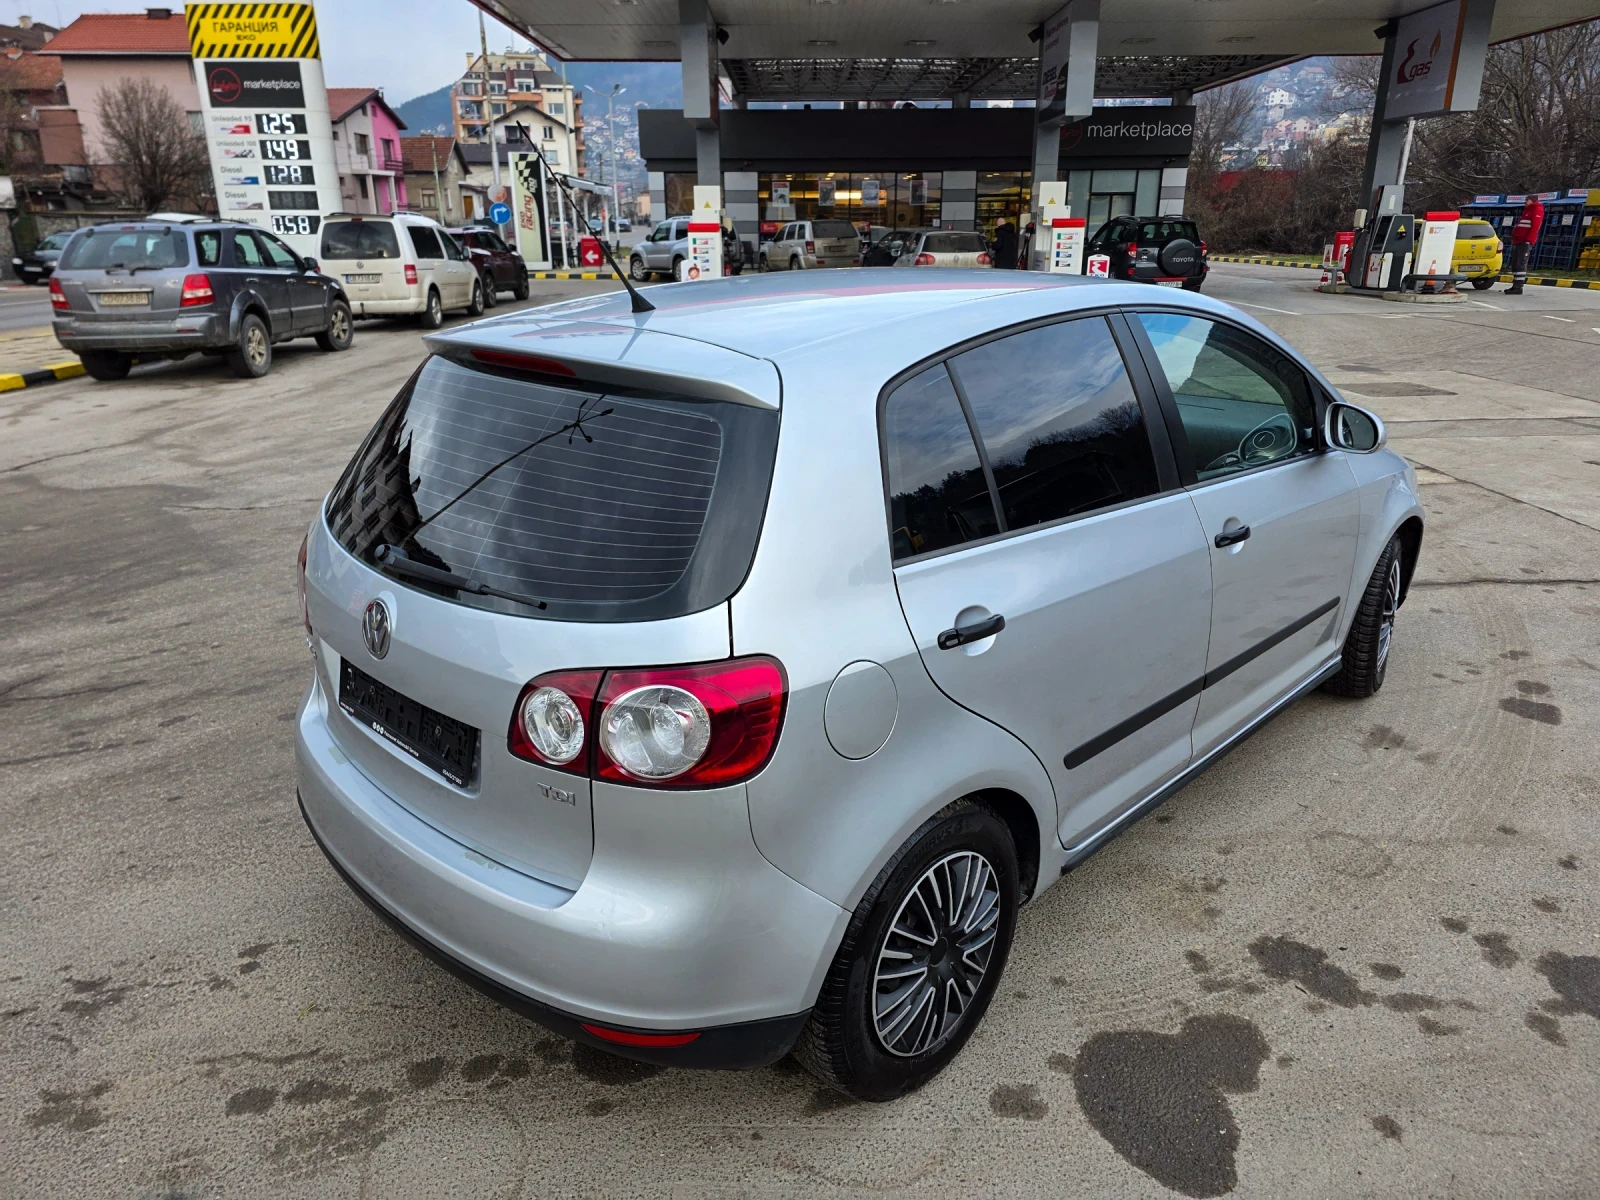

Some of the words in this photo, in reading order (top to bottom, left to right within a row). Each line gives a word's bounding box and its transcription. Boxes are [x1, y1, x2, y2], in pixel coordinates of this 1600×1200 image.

[212, 21, 278, 34] ГАРАНЦИЯ
[243, 79, 300, 90] marketplace
[262, 113, 296, 134] 1.25
[1087, 120, 1192, 140] marketplace
[266, 139, 299, 160] 1.49
[224, 191, 247, 199] Diesel
[524, 194, 534, 230] racing
[272, 216, 310, 235] 0.58
[537, 782, 576, 806] TDI
